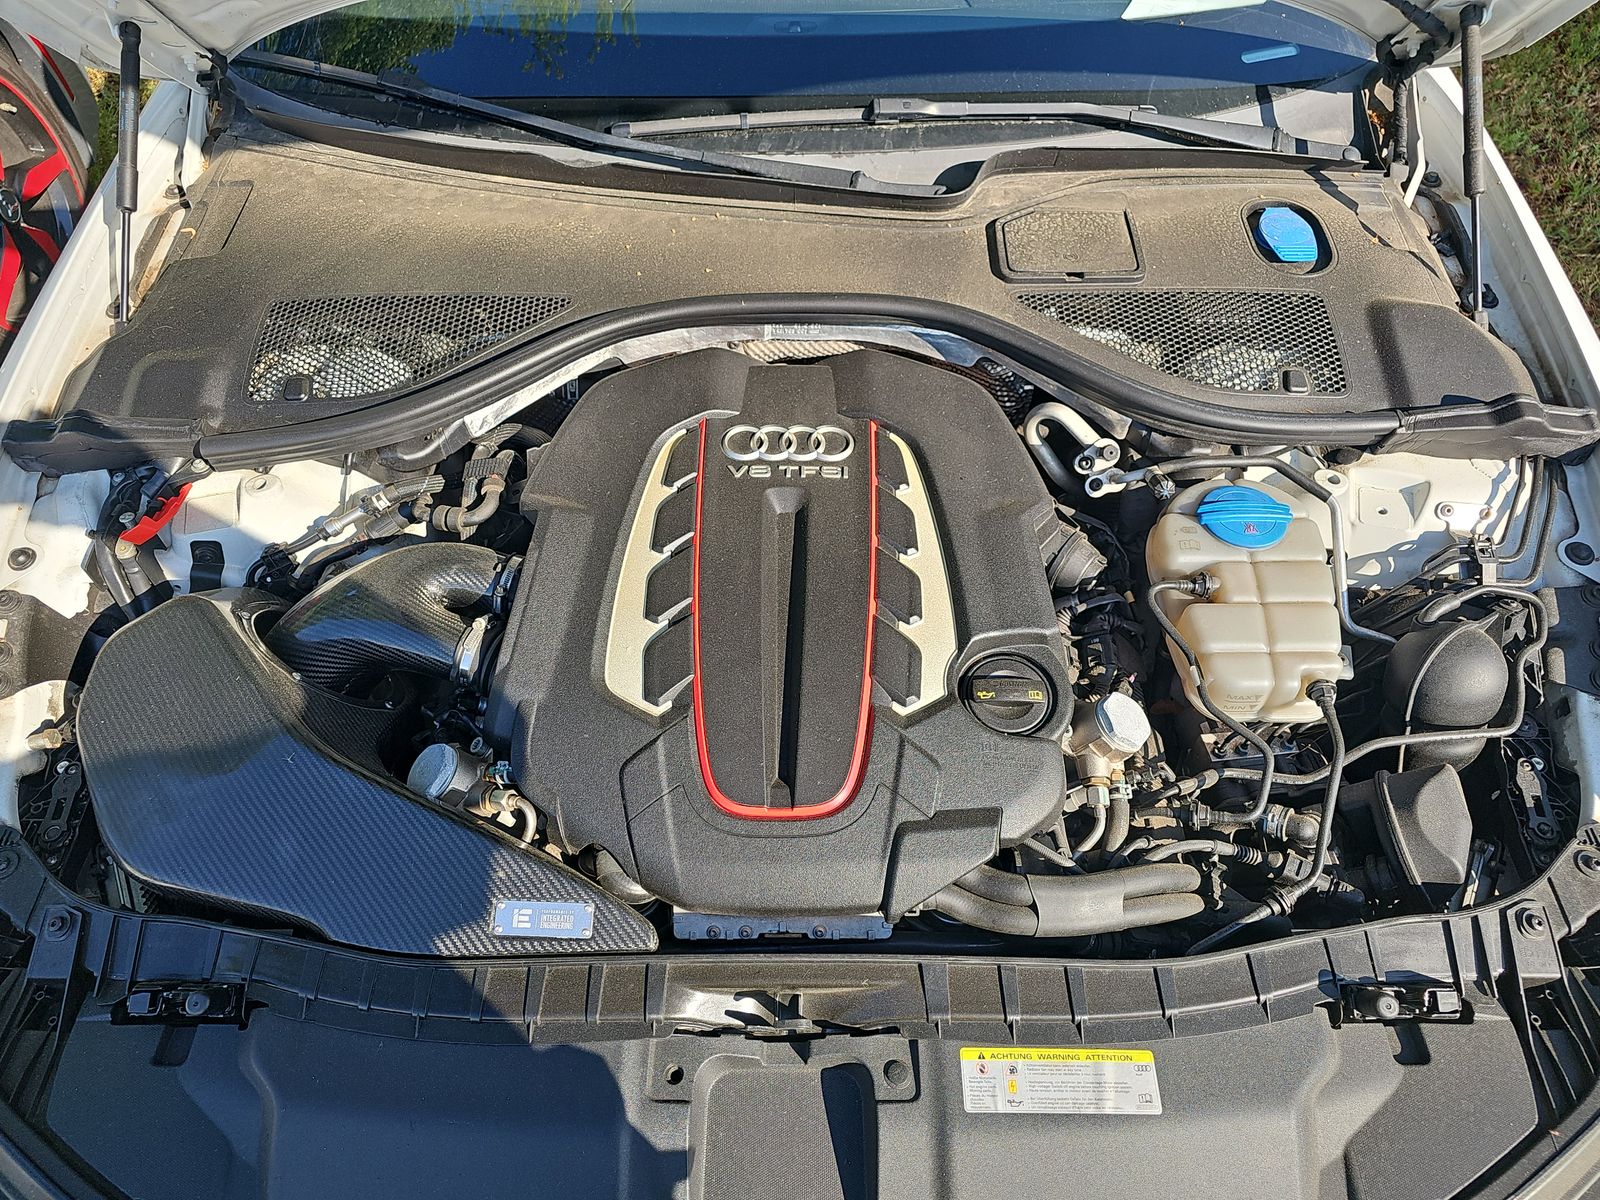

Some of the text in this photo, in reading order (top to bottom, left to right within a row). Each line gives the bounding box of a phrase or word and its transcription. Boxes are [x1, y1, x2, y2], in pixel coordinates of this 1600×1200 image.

[726, 465, 849, 479] V8 TFSI
[540, 914, 574, 923] INTEGRATED
[1037, 1053, 1080, 1061] WARNING
[1085, 1054, 1133, 1062] ATTENTION
